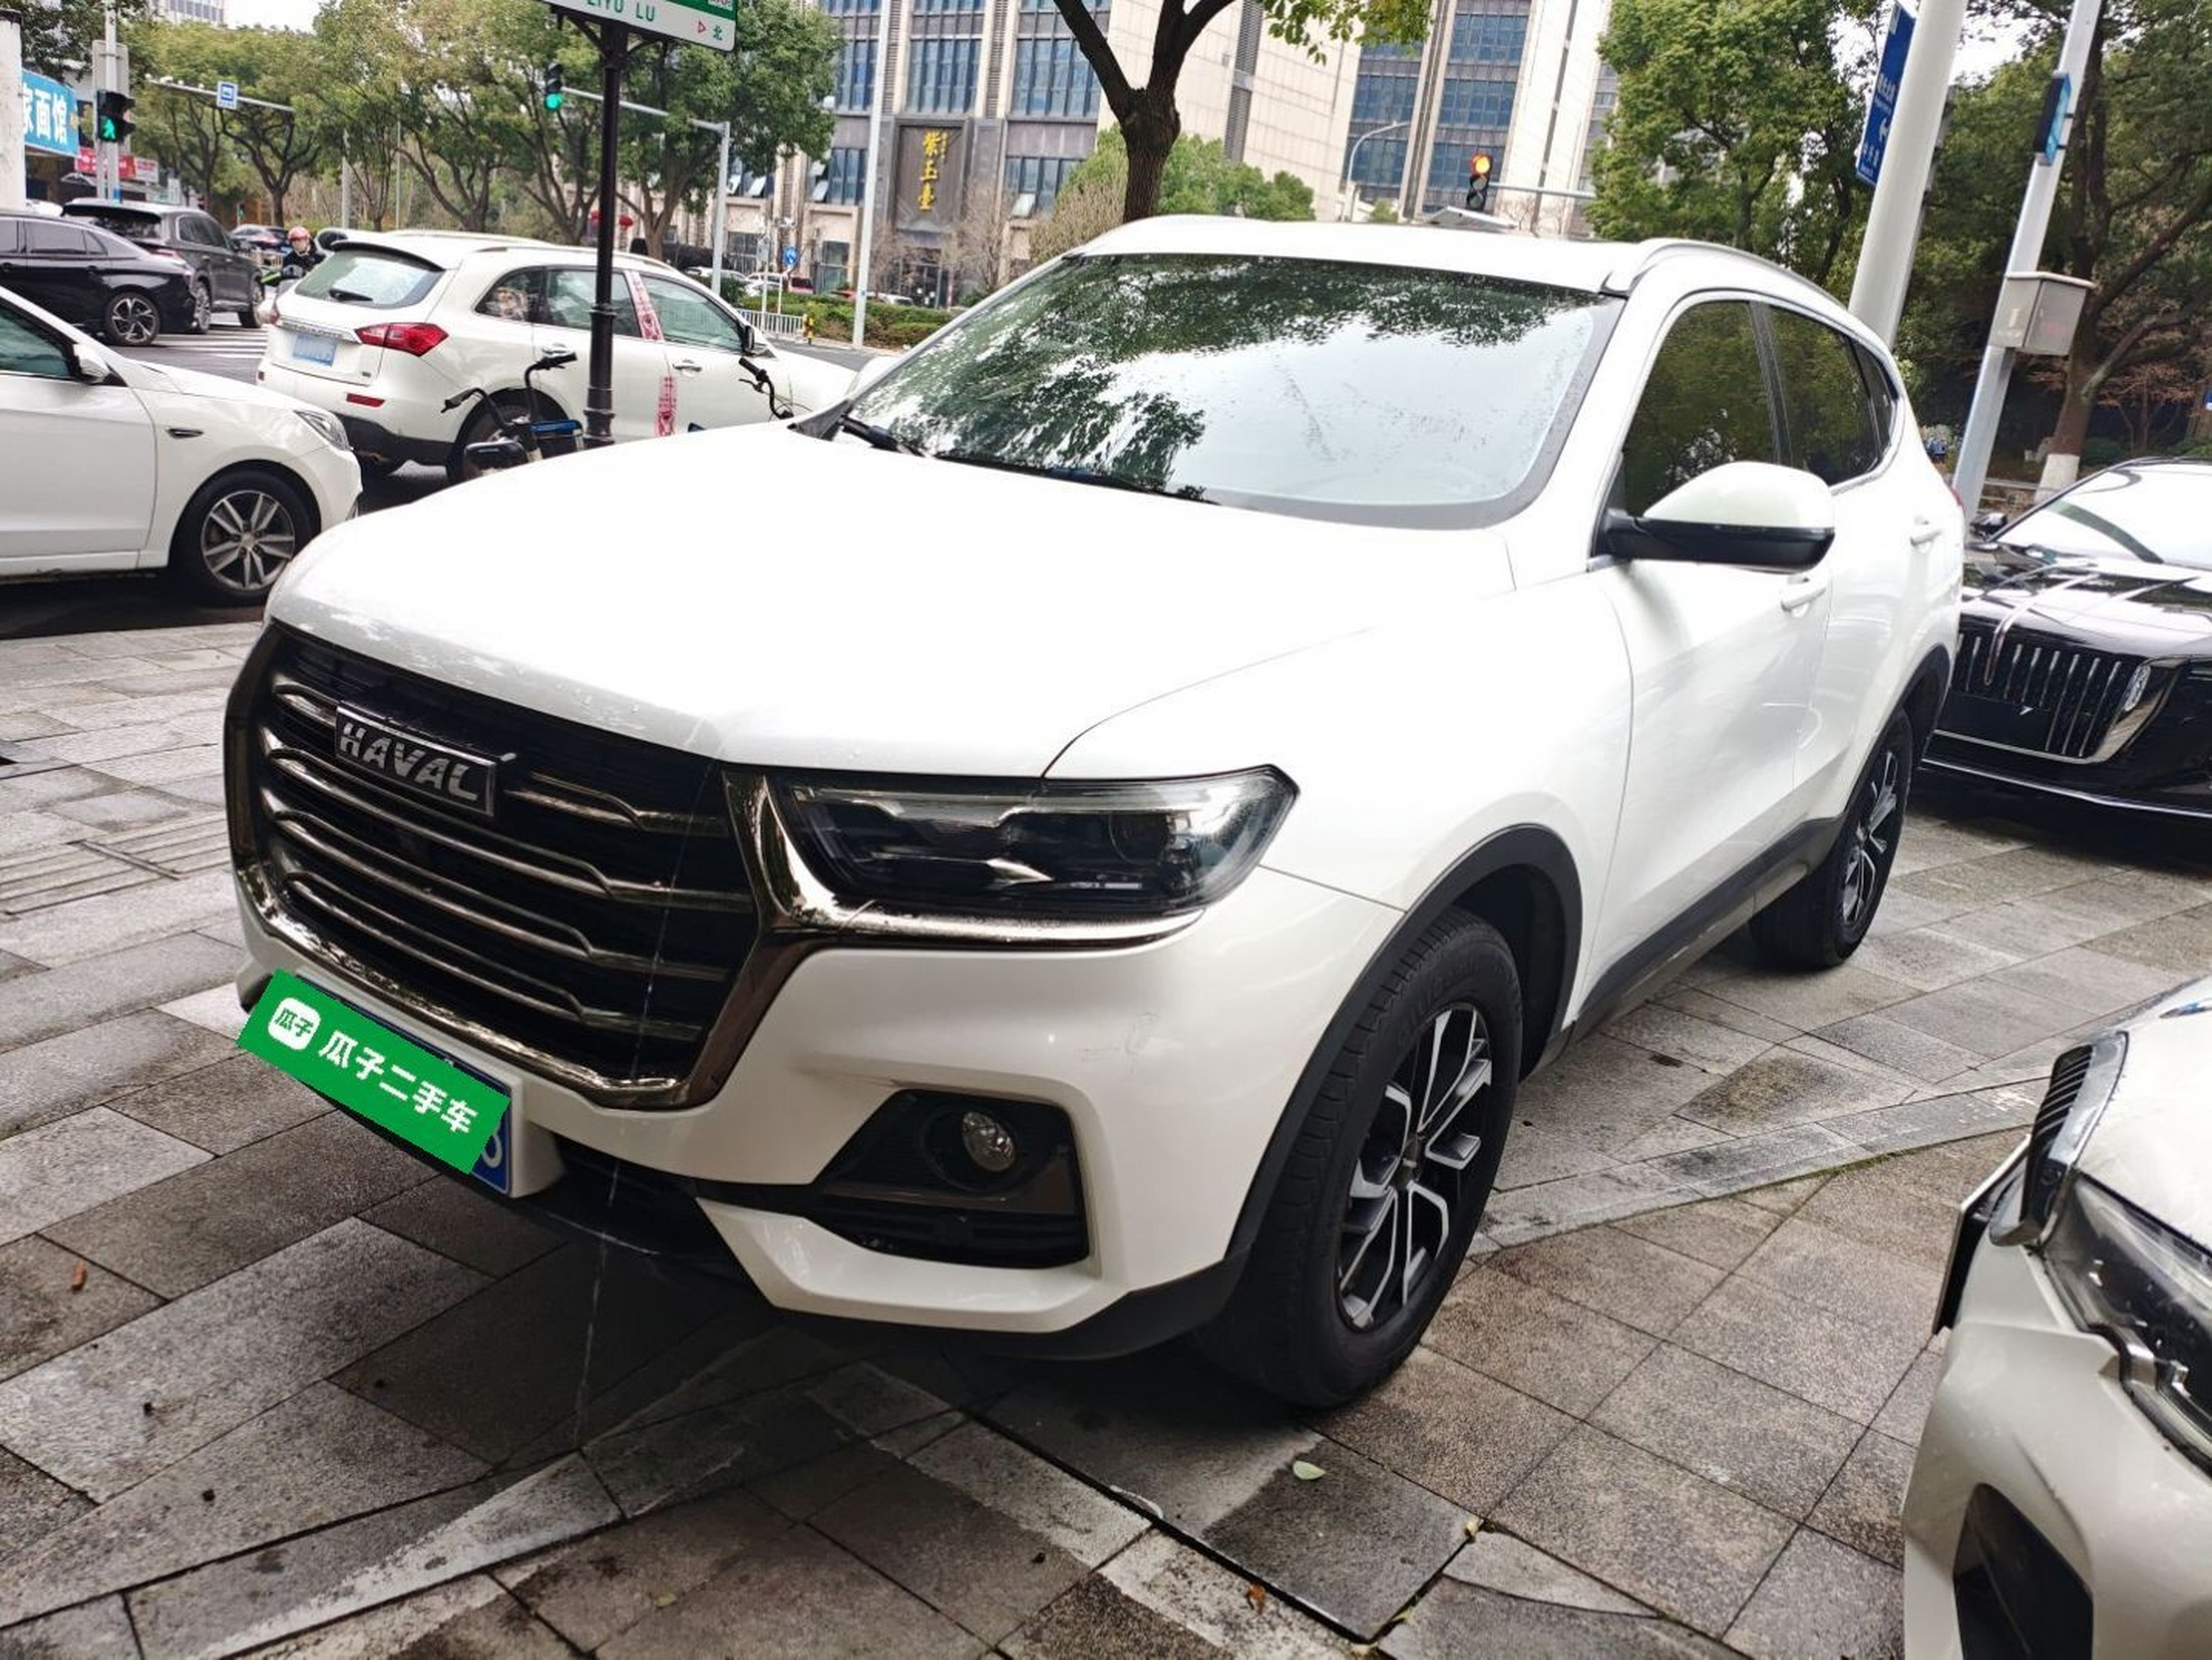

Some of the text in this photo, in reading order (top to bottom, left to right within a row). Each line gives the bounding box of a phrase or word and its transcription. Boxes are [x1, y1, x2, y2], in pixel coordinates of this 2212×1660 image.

[635, 2, 655, 22] LU
[713, 24, 723, 40] 北
[340, 722, 478, 801] HAVAL
